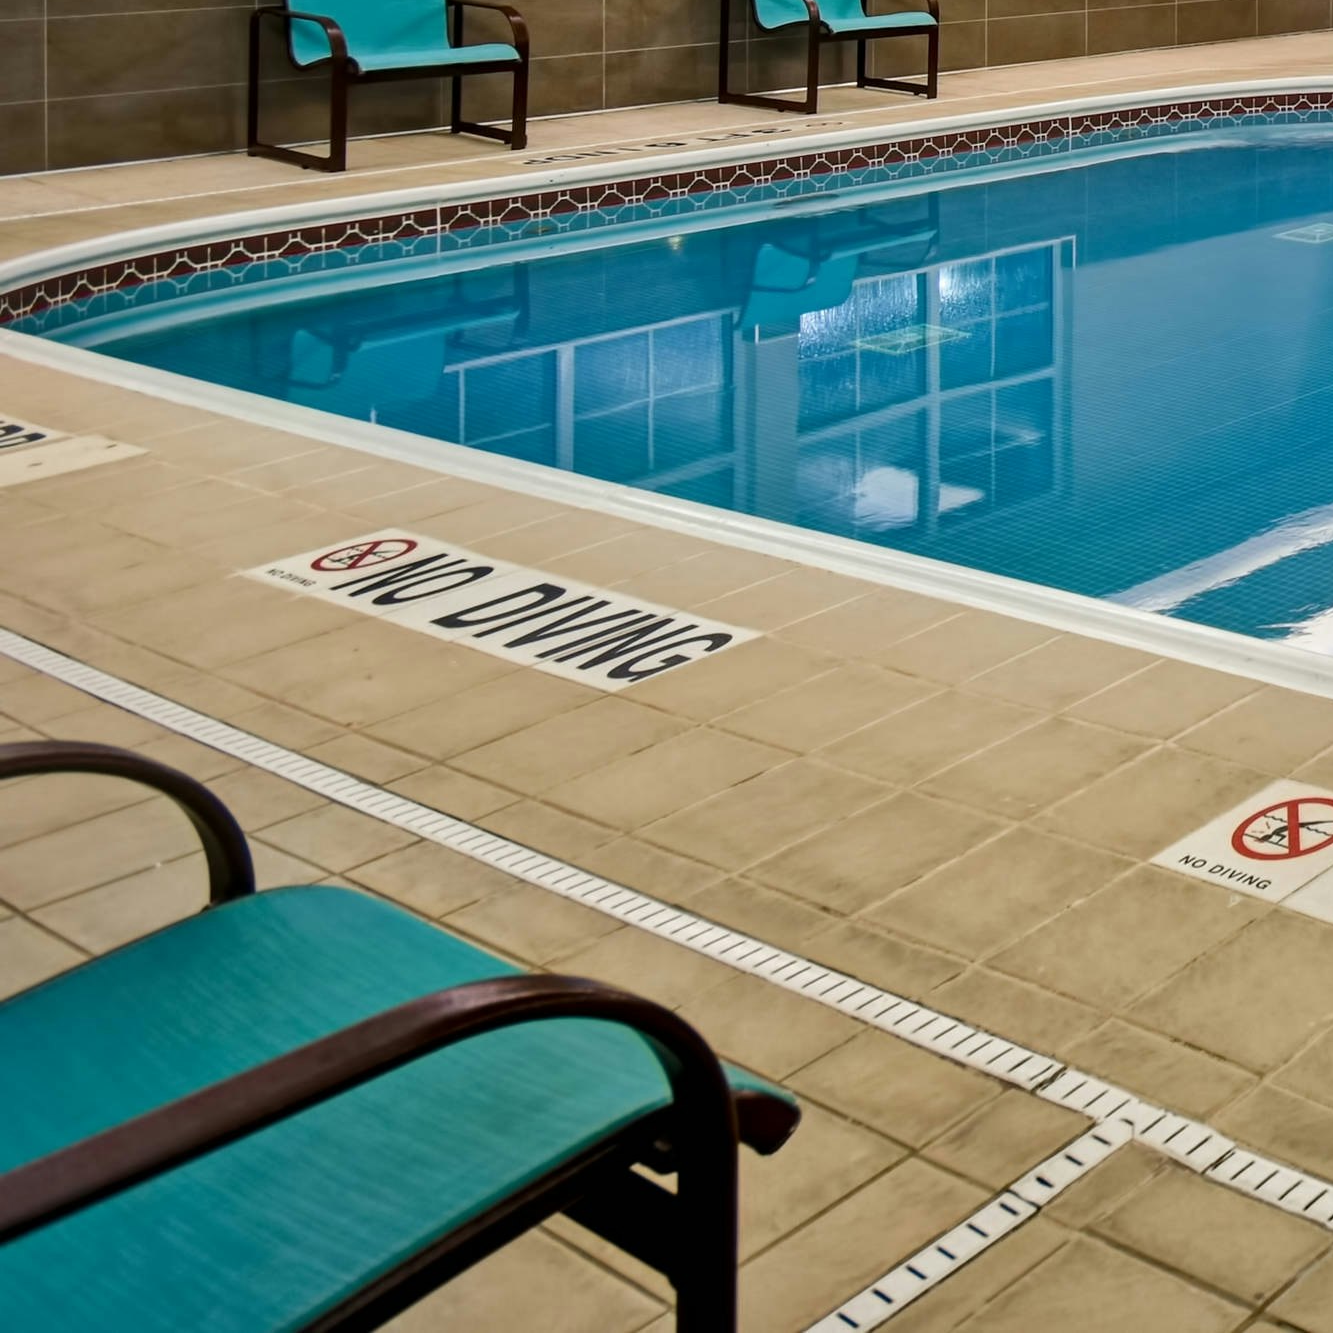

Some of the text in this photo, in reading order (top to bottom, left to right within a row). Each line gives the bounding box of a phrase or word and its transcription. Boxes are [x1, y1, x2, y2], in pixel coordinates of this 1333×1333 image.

[329, 553, 734, 683] NO DIVING
[1178, 854, 1273, 890] NO DIVING
